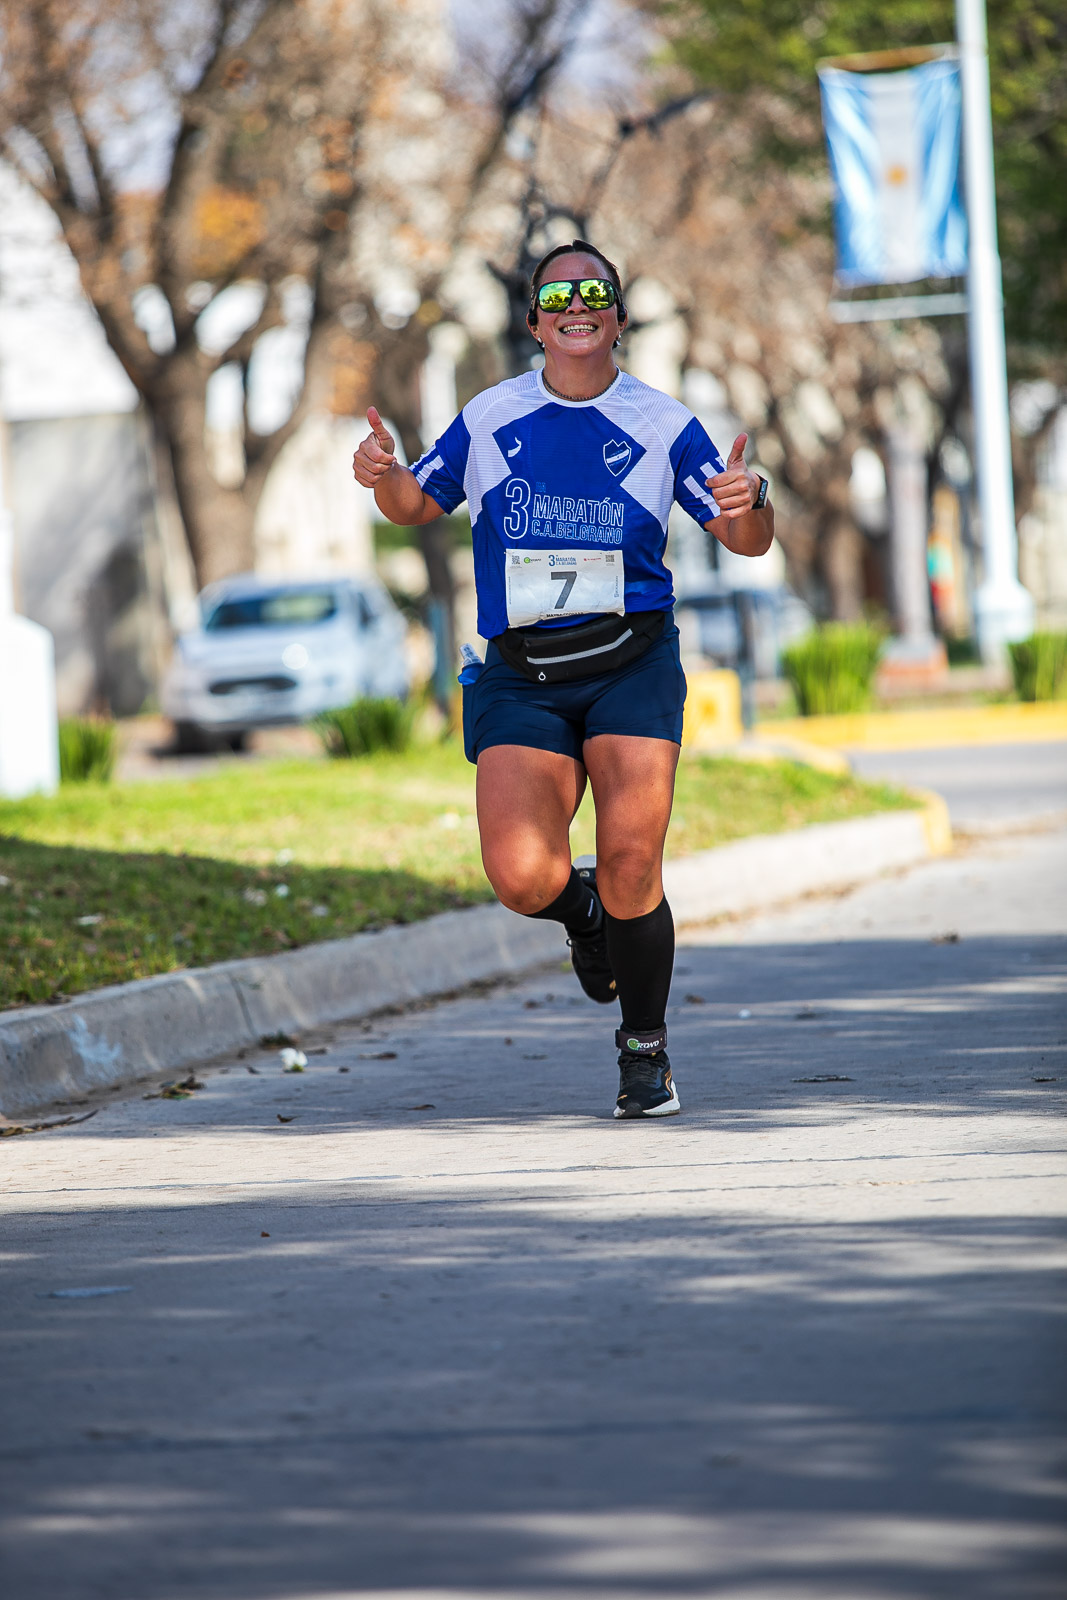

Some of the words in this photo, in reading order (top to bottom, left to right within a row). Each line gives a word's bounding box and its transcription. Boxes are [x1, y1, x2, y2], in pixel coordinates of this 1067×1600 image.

[504, 478, 531, 539] 3
[532, 494, 624, 527] MARATÓN
[548, 554, 556, 567] 3
[551, 571, 577, 609] 7
